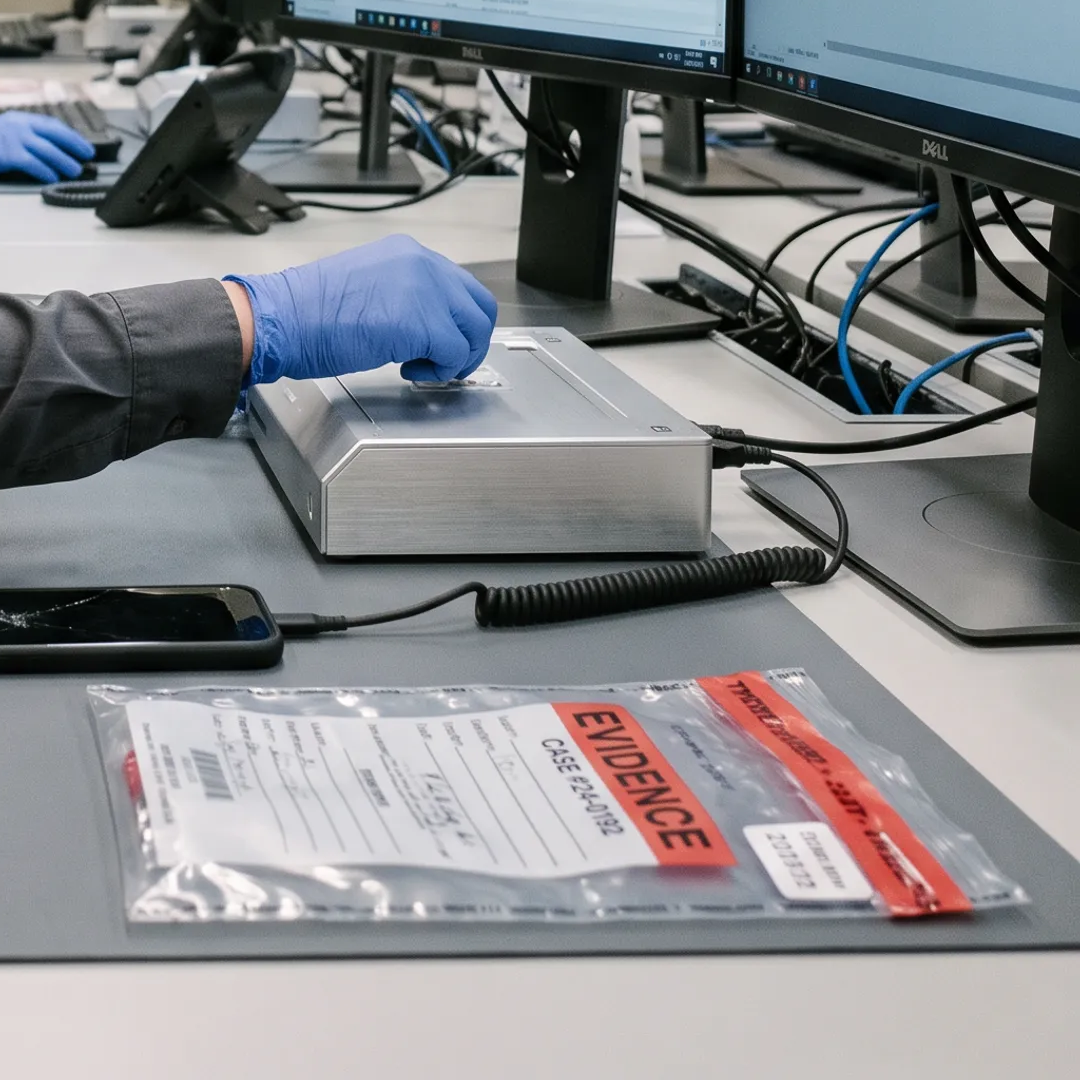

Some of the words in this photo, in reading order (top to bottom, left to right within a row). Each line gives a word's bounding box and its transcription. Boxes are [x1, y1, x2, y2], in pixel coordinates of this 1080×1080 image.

[462, 46, 484, 60] DELL
[922, 138, 949, 161] DELL
[541, 738, 582, 773] CASE
[568, 774, 625, 836] #24-0192
[572, 711, 712, 850] EVIDENCE
